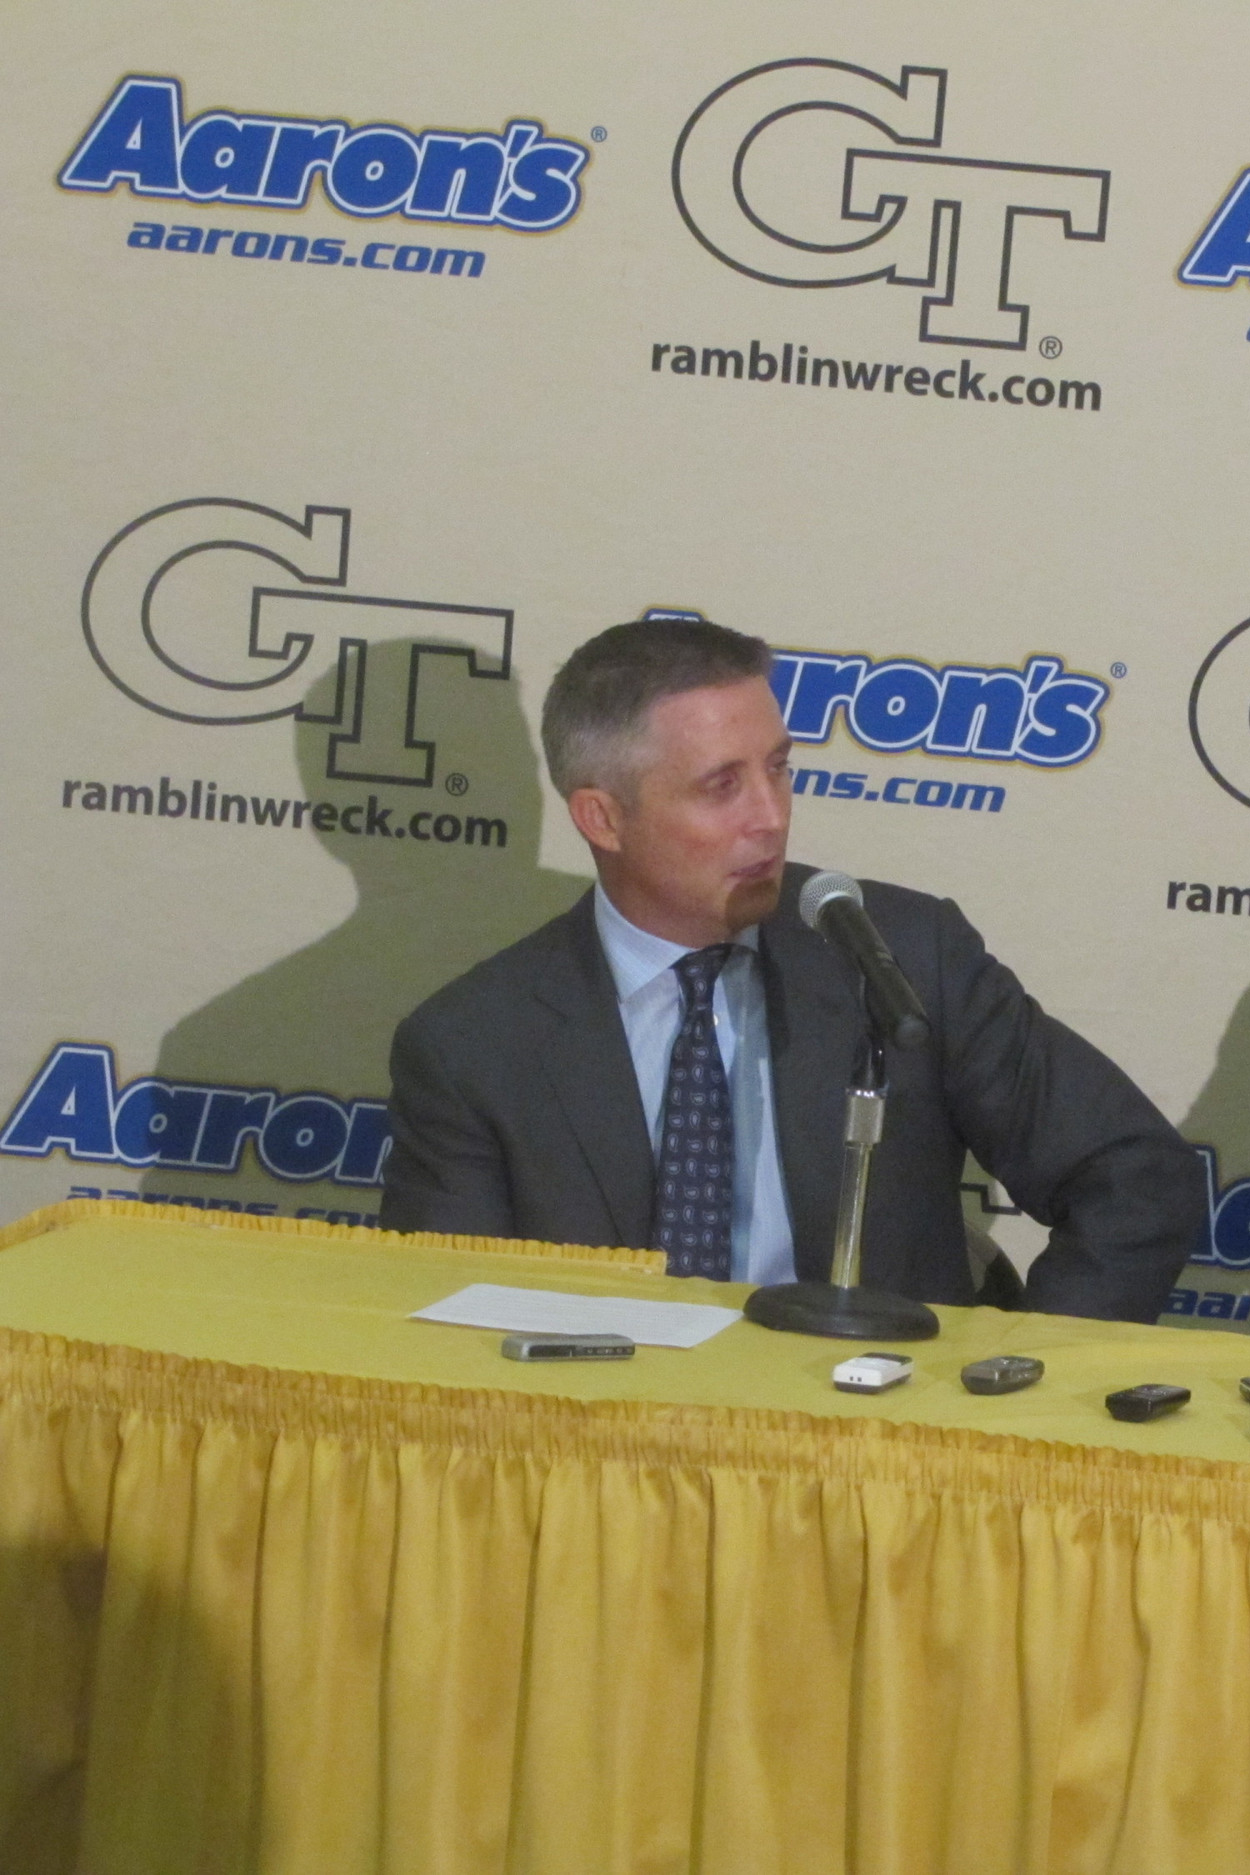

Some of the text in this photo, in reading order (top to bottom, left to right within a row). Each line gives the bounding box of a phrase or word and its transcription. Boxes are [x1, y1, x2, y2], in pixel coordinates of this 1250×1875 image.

[59, 74, 589, 231] Aaron's
[127, 221, 487, 278] aarons.com
[651, 339, 1102, 412] ramblinwreck.com
[62, 776, 509, 848] ramblinwreck.com
[791, 767, 1006, 813] ns.com
